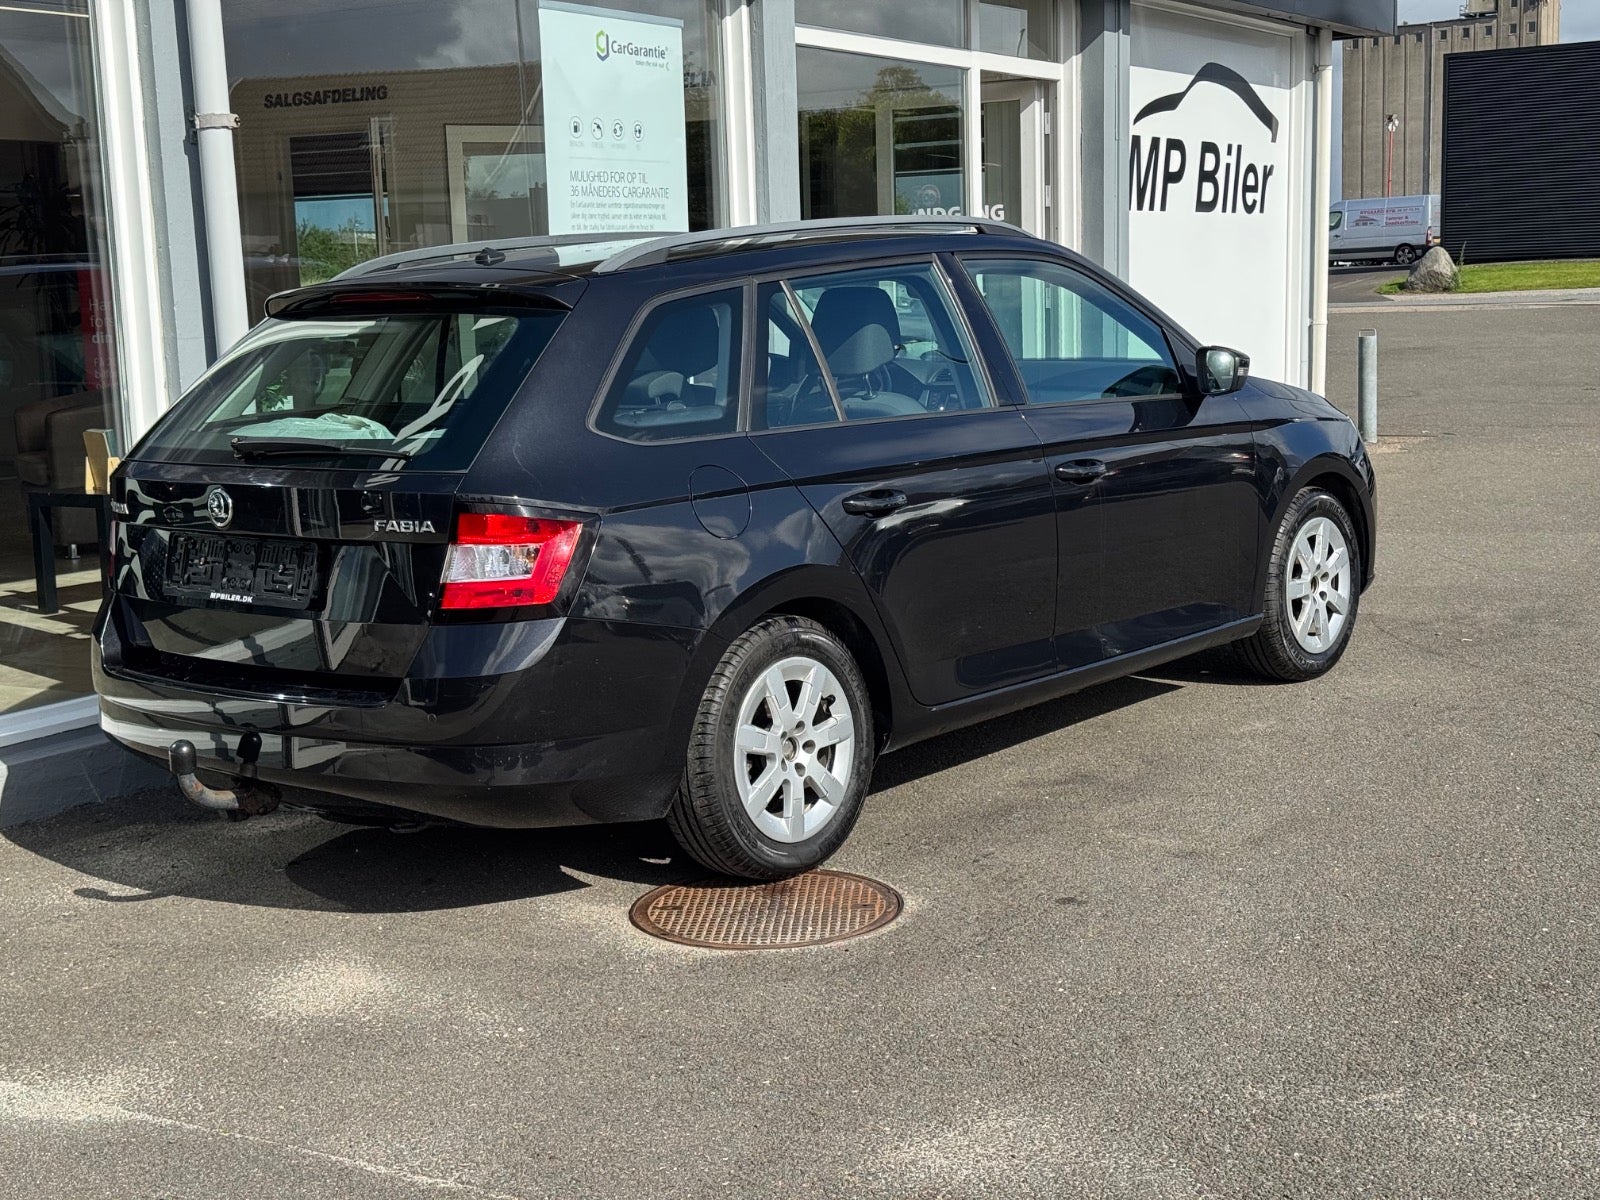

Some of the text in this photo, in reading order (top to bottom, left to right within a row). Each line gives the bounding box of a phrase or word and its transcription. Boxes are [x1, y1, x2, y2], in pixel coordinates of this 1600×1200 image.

[611, 40, 666, 59] CarGarantie
[264, 85, 388, 108] SALGSAFDELING
[569, 170, 648, 184] MULIGHED FOR OP TIL
[1129, 135, 1275, 214] MP Biler
[570, 183, 670, 199] 36 MÅNEDERS CARGARANTIE
[374, 519, 436, 533] FABIA
[209, 592, 253, 603] MPBILER.DK
